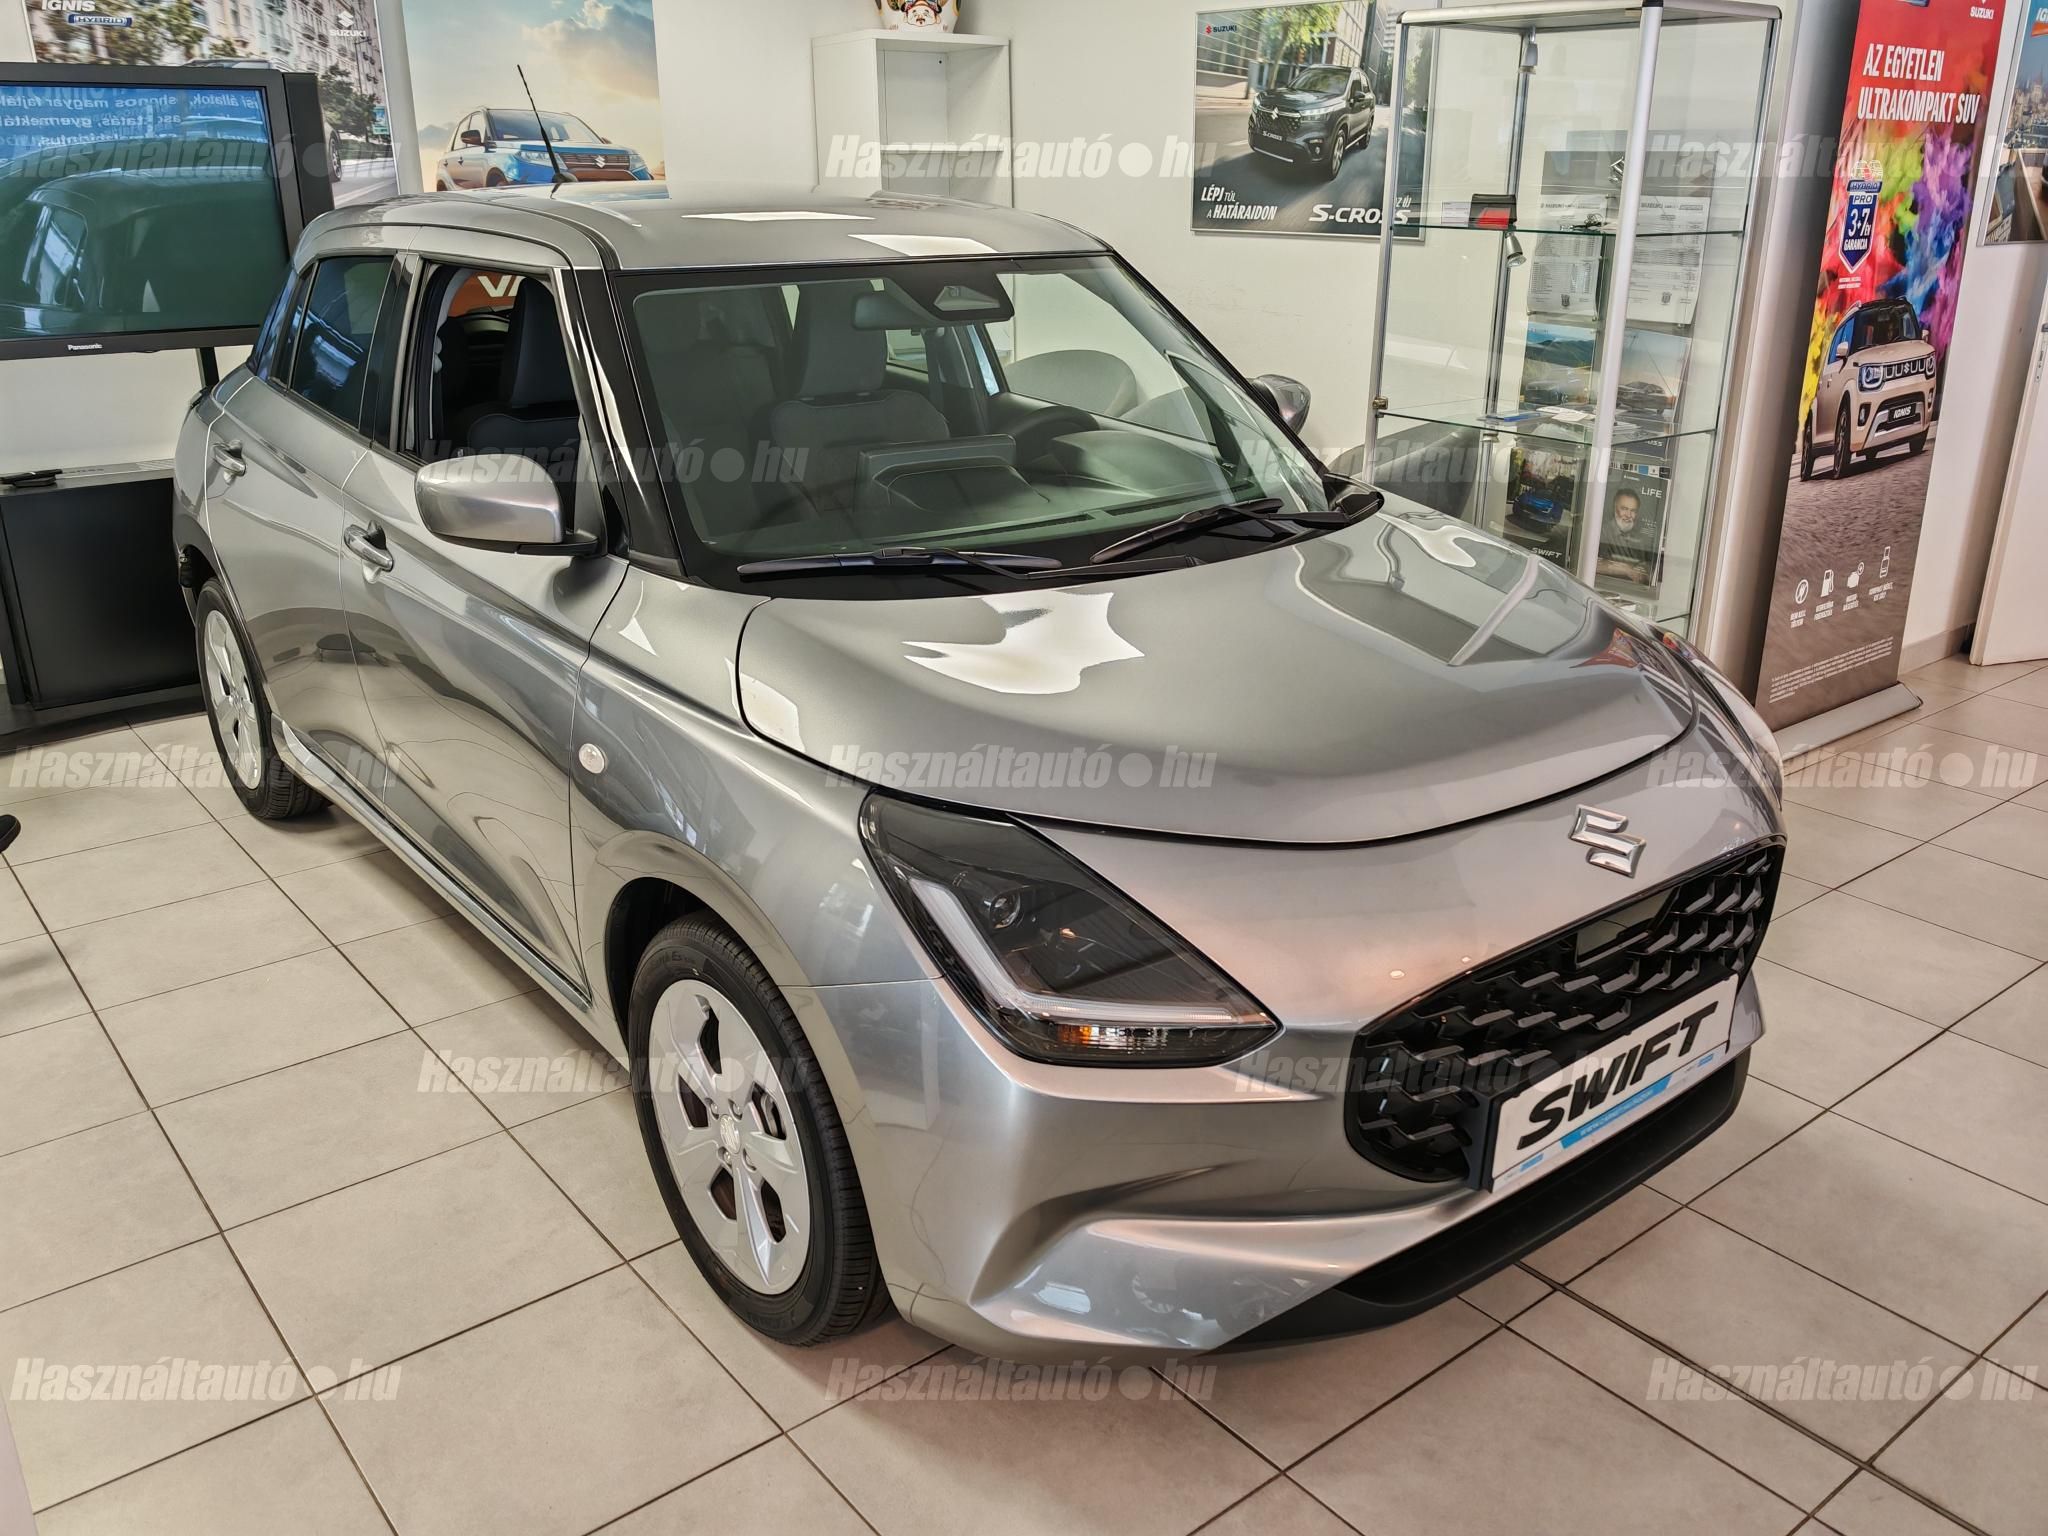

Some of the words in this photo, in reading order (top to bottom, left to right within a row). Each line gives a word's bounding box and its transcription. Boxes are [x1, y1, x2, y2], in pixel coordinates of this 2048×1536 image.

[41, 0, 97, 11] IGNIS
[76, 15, 125, 24] HYBRID
[1969, 6, 1994, 20] SUZUKI
[1862, 43, 1884, 77] AZ
[1883, 45, 1945, 82] EGYETLEN
[1857, 86, 1958, 123] ULTRAKOMPAKT
[1955, 93, 1981, 125] SUV
[1201, 184, 1225, 202] LÉPJ
[1853, 194, 1873, 204] PRO
[1206, 208, 1213, 219] A
[1212, 202, 1278, 221] HATÁRAIDON
[67, 343, 103, 351] Panasonic
[1893, 406, 1911, 419] IGNIS
[1641, 486, 1662, 498] LIFE
[1531, 547, 1562, 558] SWIFT
[1516, 1001, 1719, 1150] SWIFT
